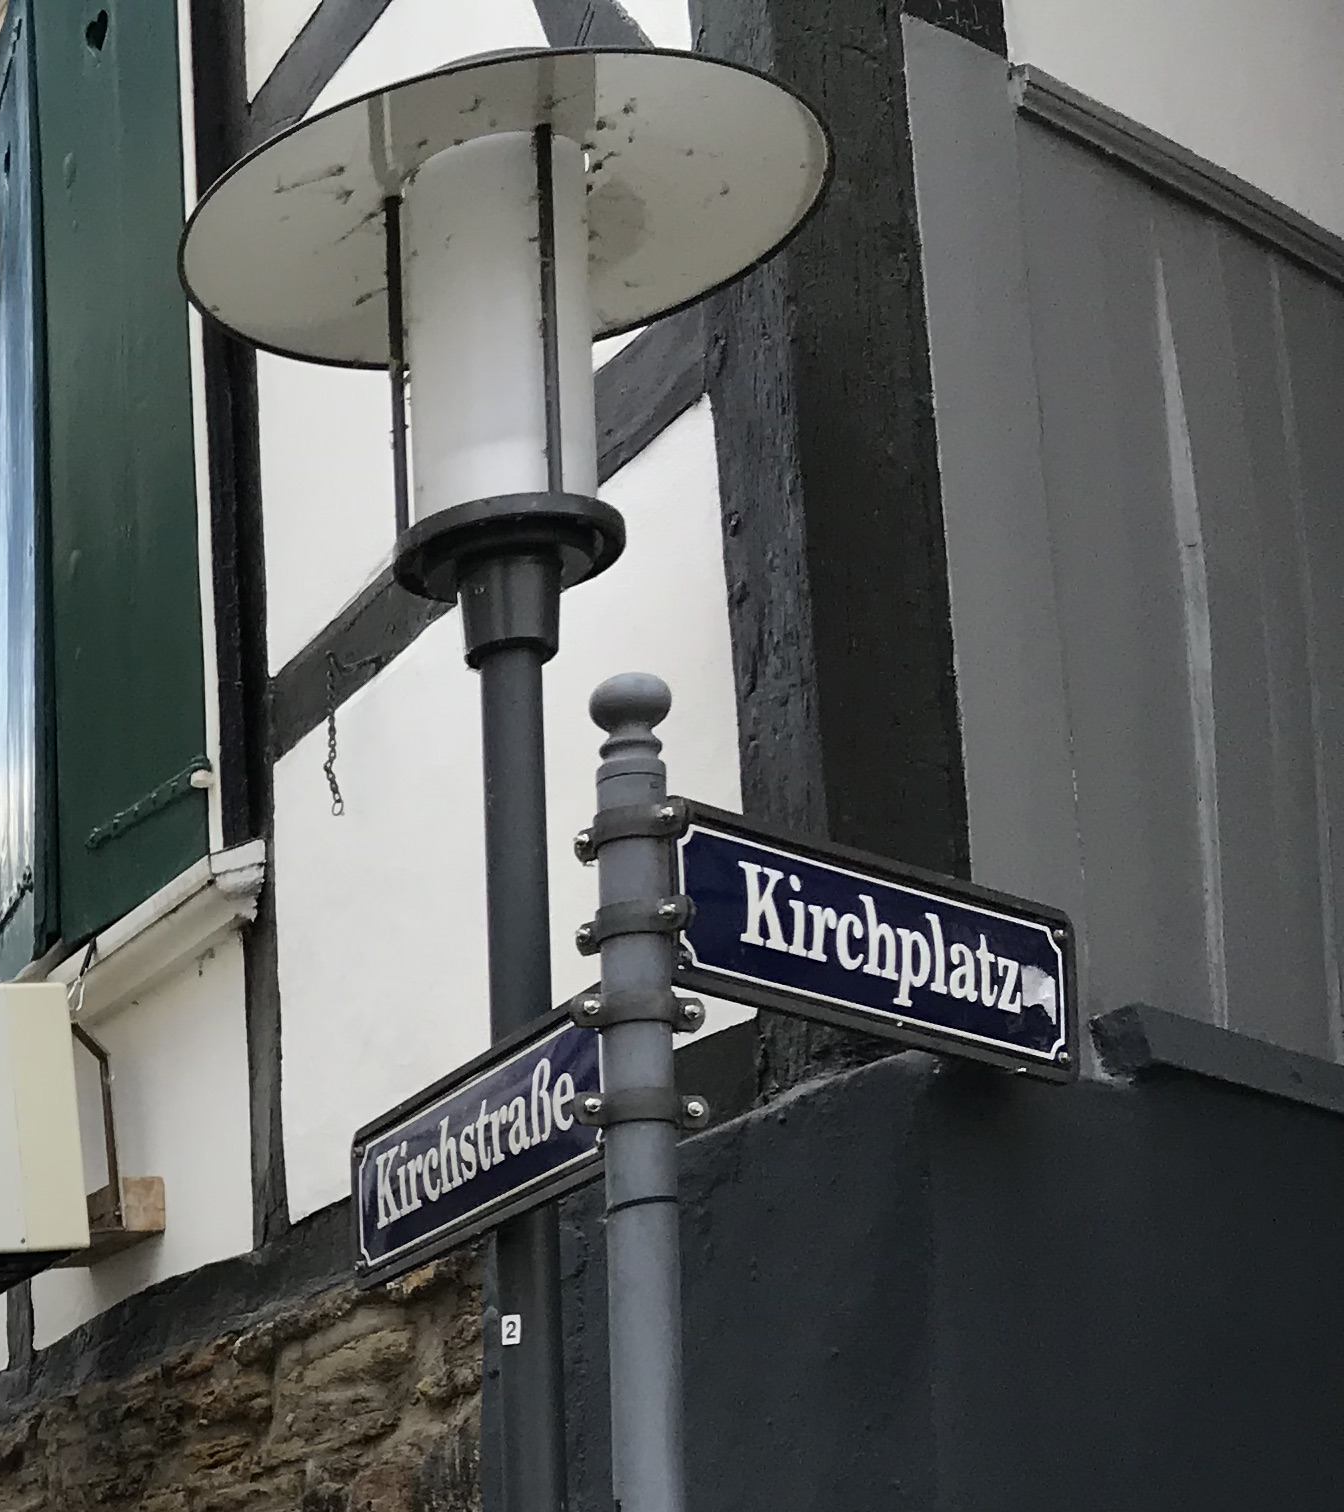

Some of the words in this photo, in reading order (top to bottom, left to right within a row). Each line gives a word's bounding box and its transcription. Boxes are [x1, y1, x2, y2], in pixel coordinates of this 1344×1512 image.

[738, 860, 1022, 1014] Kirchplatz
[375, 1057, 575, 1230] Kirchstraße
[505, 1320, 517, 1339] 2
